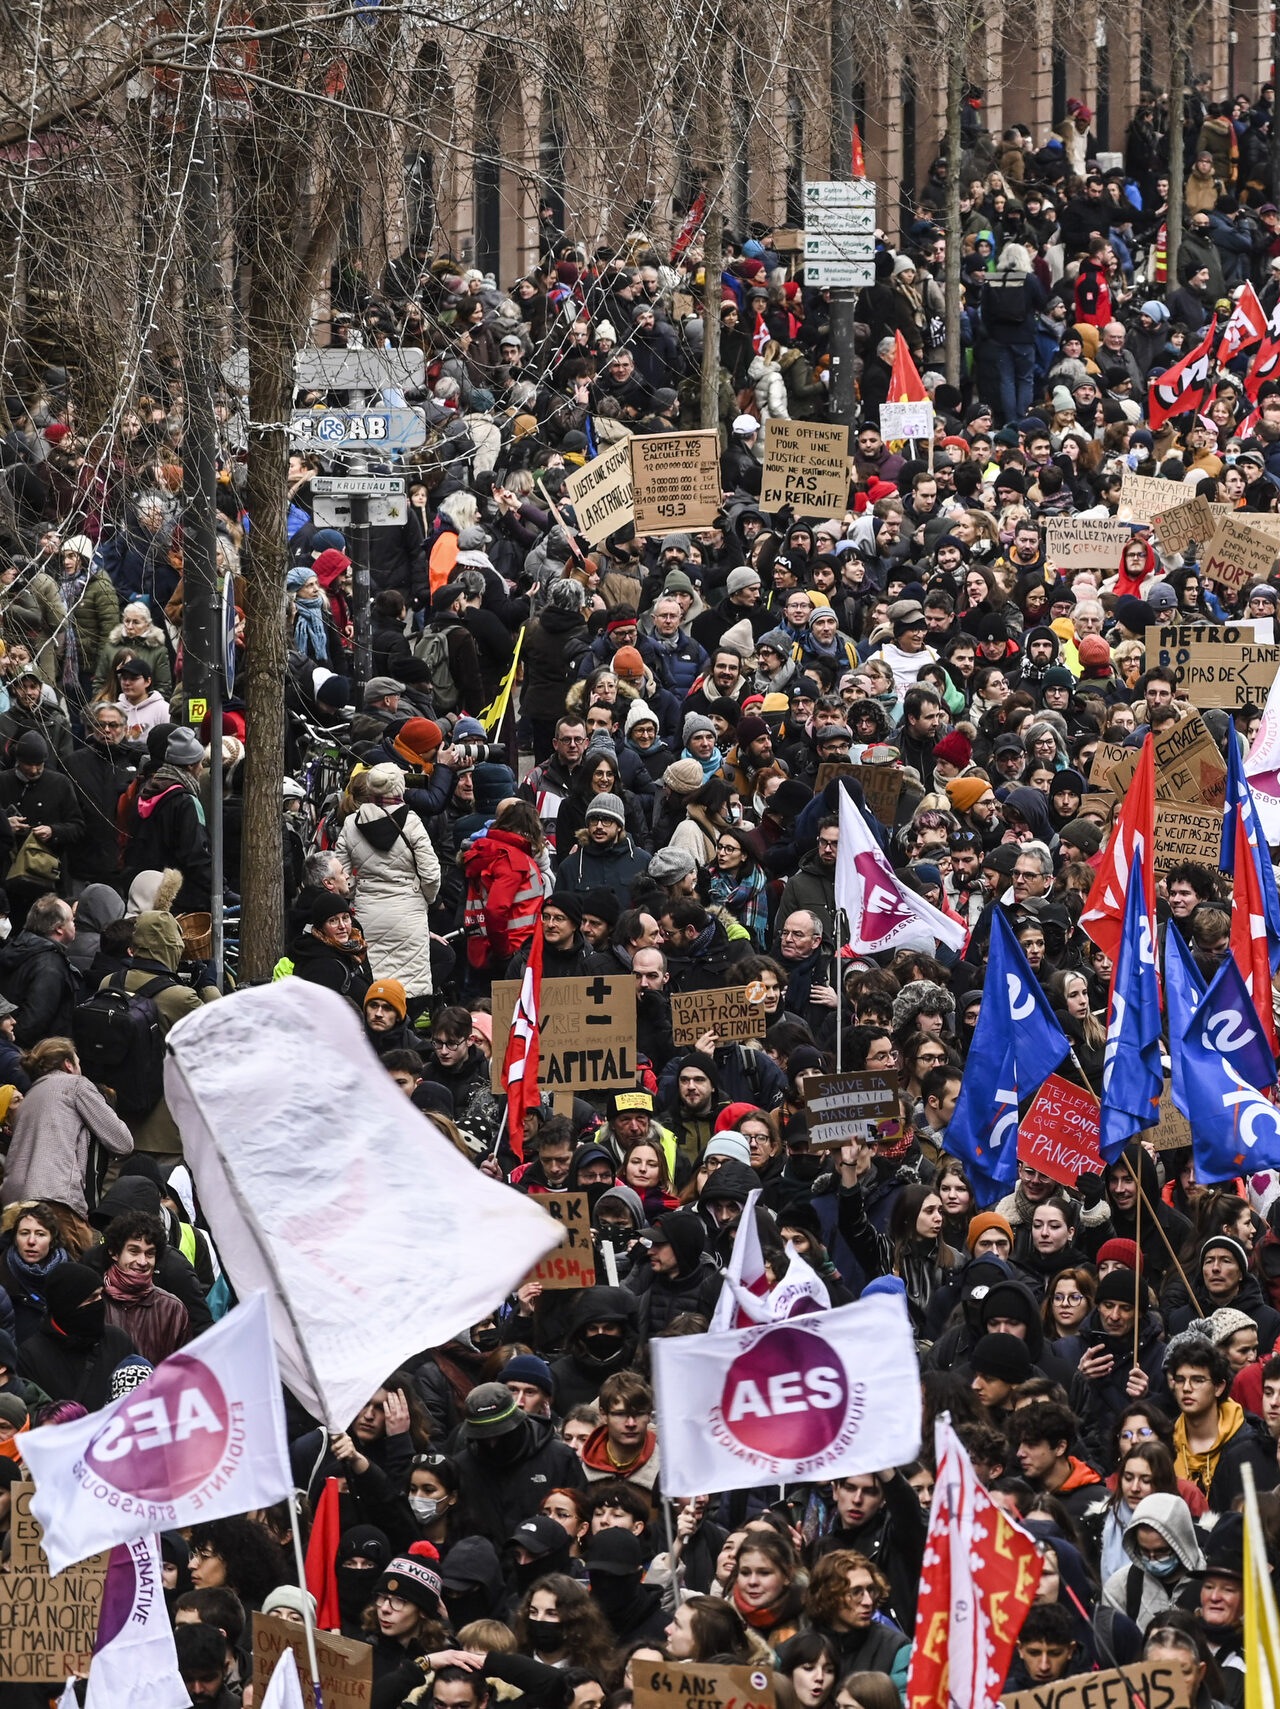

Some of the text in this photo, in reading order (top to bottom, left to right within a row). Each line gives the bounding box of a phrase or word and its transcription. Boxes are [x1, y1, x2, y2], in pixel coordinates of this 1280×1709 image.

[771, 426, 843, 440] UNE OFFENSIVE
[642, 440, 700, 453] SORTEZ VOS
[776, 439, 830, 452] POUR UNE
[768, 452, 843, 468] JUSTICE SOCIALE
[644, 464, 653, 472] 12
[766, 464, 798, 474] NOUS NE
[337, 480, 386, 491] KRUTENAU
[573, 466, 607, 504] JUSTE UNE
[786, 475, 817, 490] PAS
[1124, 475, 1139, 487] MA
[765, 489, 843, 508] EN RETRAITE
[1122, 488, 1137, 497] EST
[1121, 497, 1133, 505] MA
[658, 503, 686, 516] 49.3
[582, 506, 595, 531] LA
[1048, 519, 1116, 529] AVEC MACRON
[1160, 512, 1208, 538] BOULOT
[1102, 534, 1131, 544] PAYEZ
[1051, 543, 1109, 555] PUIS CREVEZ
[1250, 551, 1271, 564] VIVRE
[1247, 561, 1258, 570] LA
[1159, 627, 1240, 647] METRO
[1192, 667, 1236, 683] PAS DE
[192, 703, 204, 716] FO
[1171, 768, 1192, 791] DE
[1157, 813, 1211, 828] N'EST PAS DES
[1165, 827, 1220, 844] VEUT PAS DES
[1200, 845, 1217, 858] LES
[674, 992, 744, 1009] NOUS NE
[679, 1004, 759, 1025] BATTRONS
[674, 1028, 694, 1042] PAS
[712, 1018, 766, 1038] RETRAITE
[819, 1077, 886, 1096] SAUVE TA
[820, 1105, 883, 1121] MANGE 1
[1035, 1097, 1062, 1116] PAS
[1034, 1116, 1056, 1130] QUE
[1019, 1130, 1034, 1140] UNE
[1153, 1124, 1178, 1138] AVANT
[728, 1366, 843, 1422] AES
[1, 1576, 59, 1602] VOUS
[0, 1600, 98, 1630] DÉJÀ NOTRE
[0, 1628, 15, 1648] ET
[258, 1630, 280, 1654] ON
[1, 1654, 58, 1677] NOTRE
[651, 1672, 717, 1696] 64 ANS
